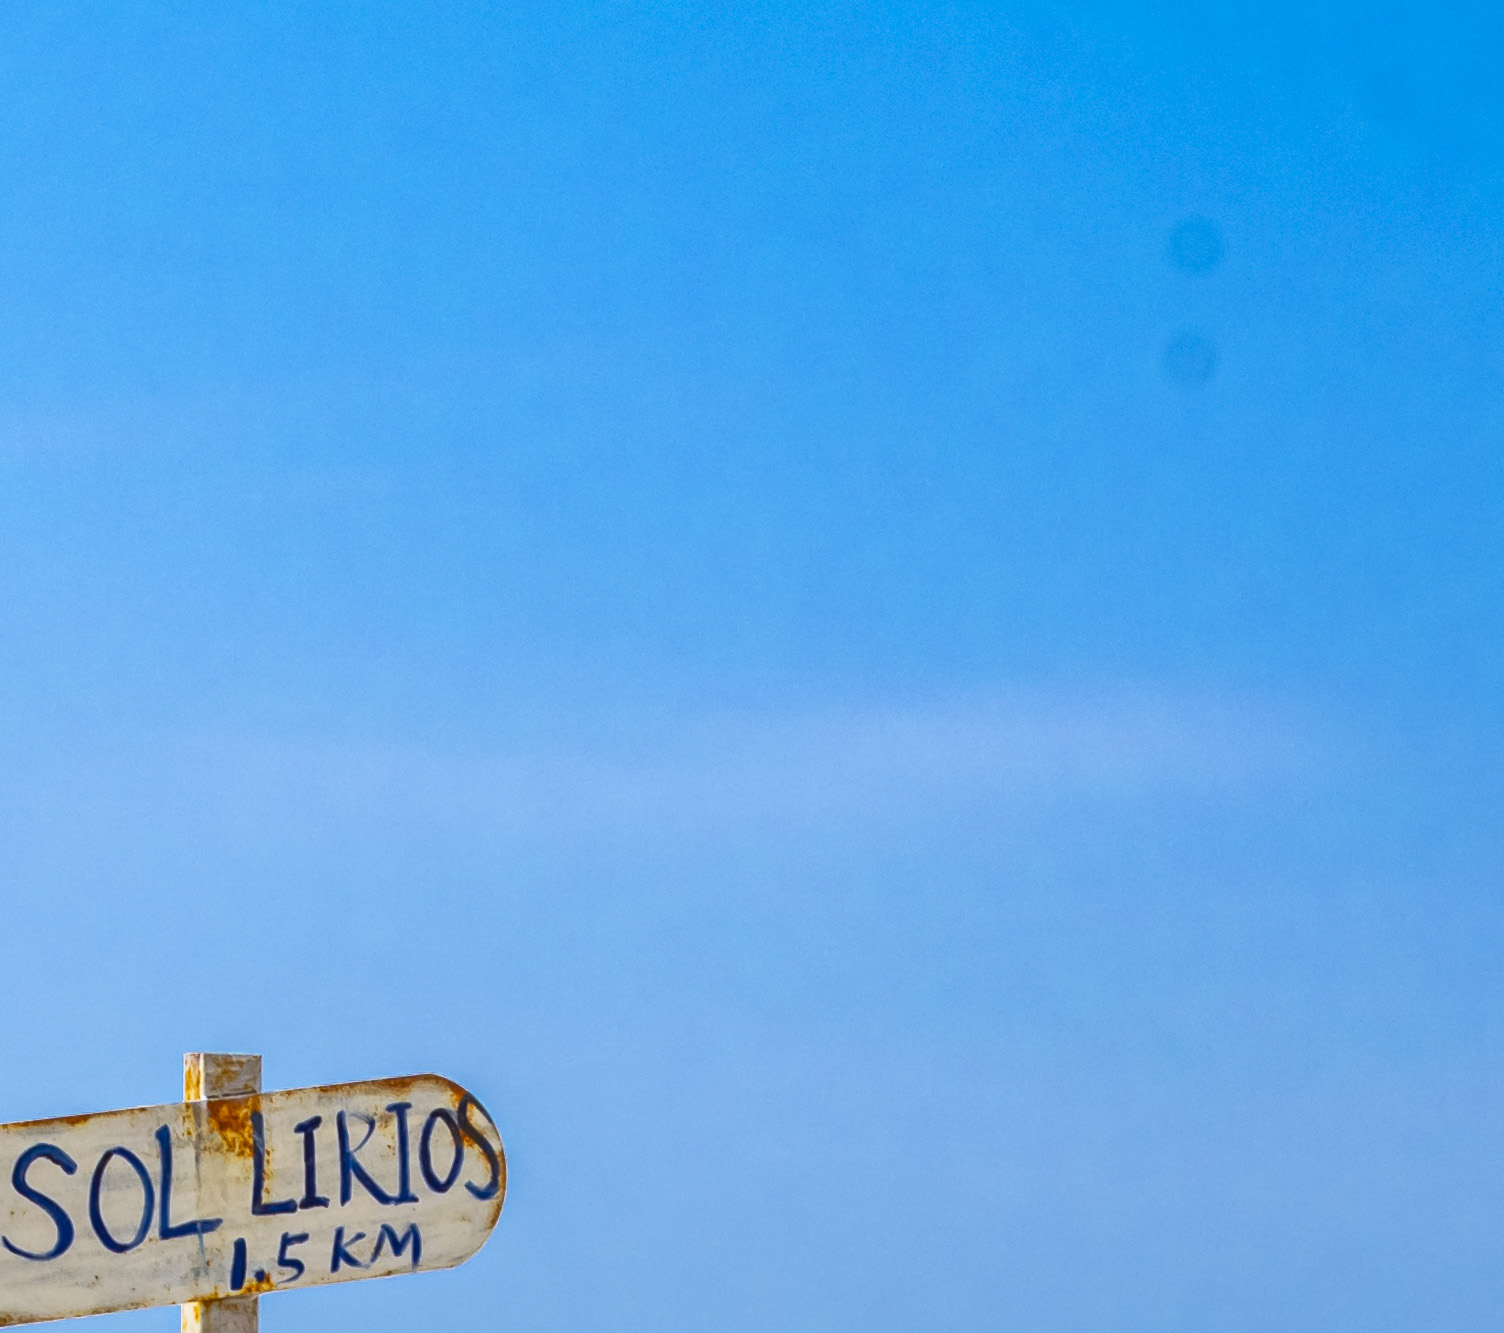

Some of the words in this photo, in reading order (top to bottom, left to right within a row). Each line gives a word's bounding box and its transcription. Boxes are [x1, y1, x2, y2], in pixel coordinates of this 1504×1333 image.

[1, 1124, 223, 1261] SOL
[251, 1096, 503, 1217] LIRIOS
[230, 1231, 309, 1291] 1.5
